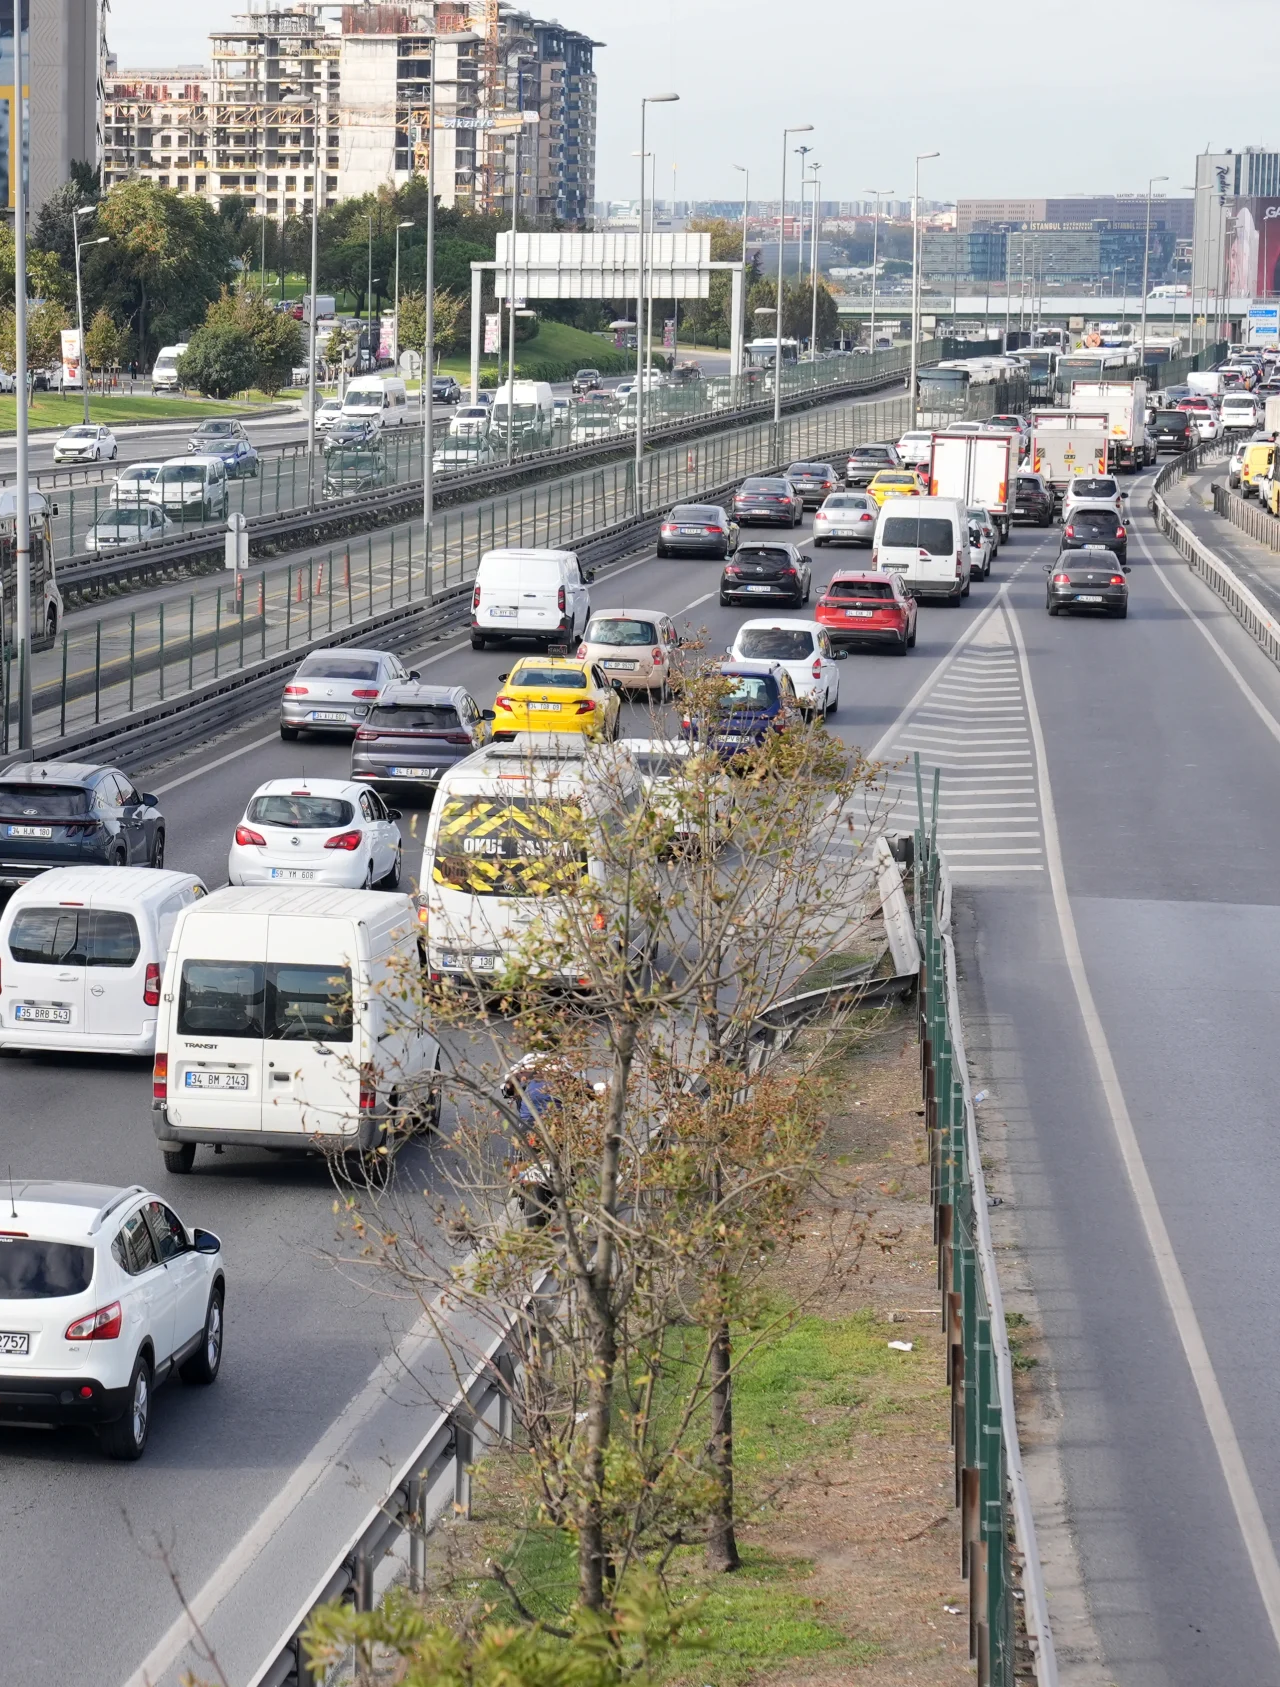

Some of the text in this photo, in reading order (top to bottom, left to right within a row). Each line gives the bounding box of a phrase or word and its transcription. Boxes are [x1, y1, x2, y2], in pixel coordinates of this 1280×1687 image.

[1030, 221, 1061, 231] İSTANBUL
[11, 827, 19, 835] 34
[463, 838, 506, 855] OKUL
[275, 869, 314, 879] 59 YM 608
[21, 1008, 31, 1018] 35
[53, 1010, 68, 1020] 543
[184, 1042, 219, 1050] TRANSIT
[191, 1073, 246, 1086] 34 BM 2143
